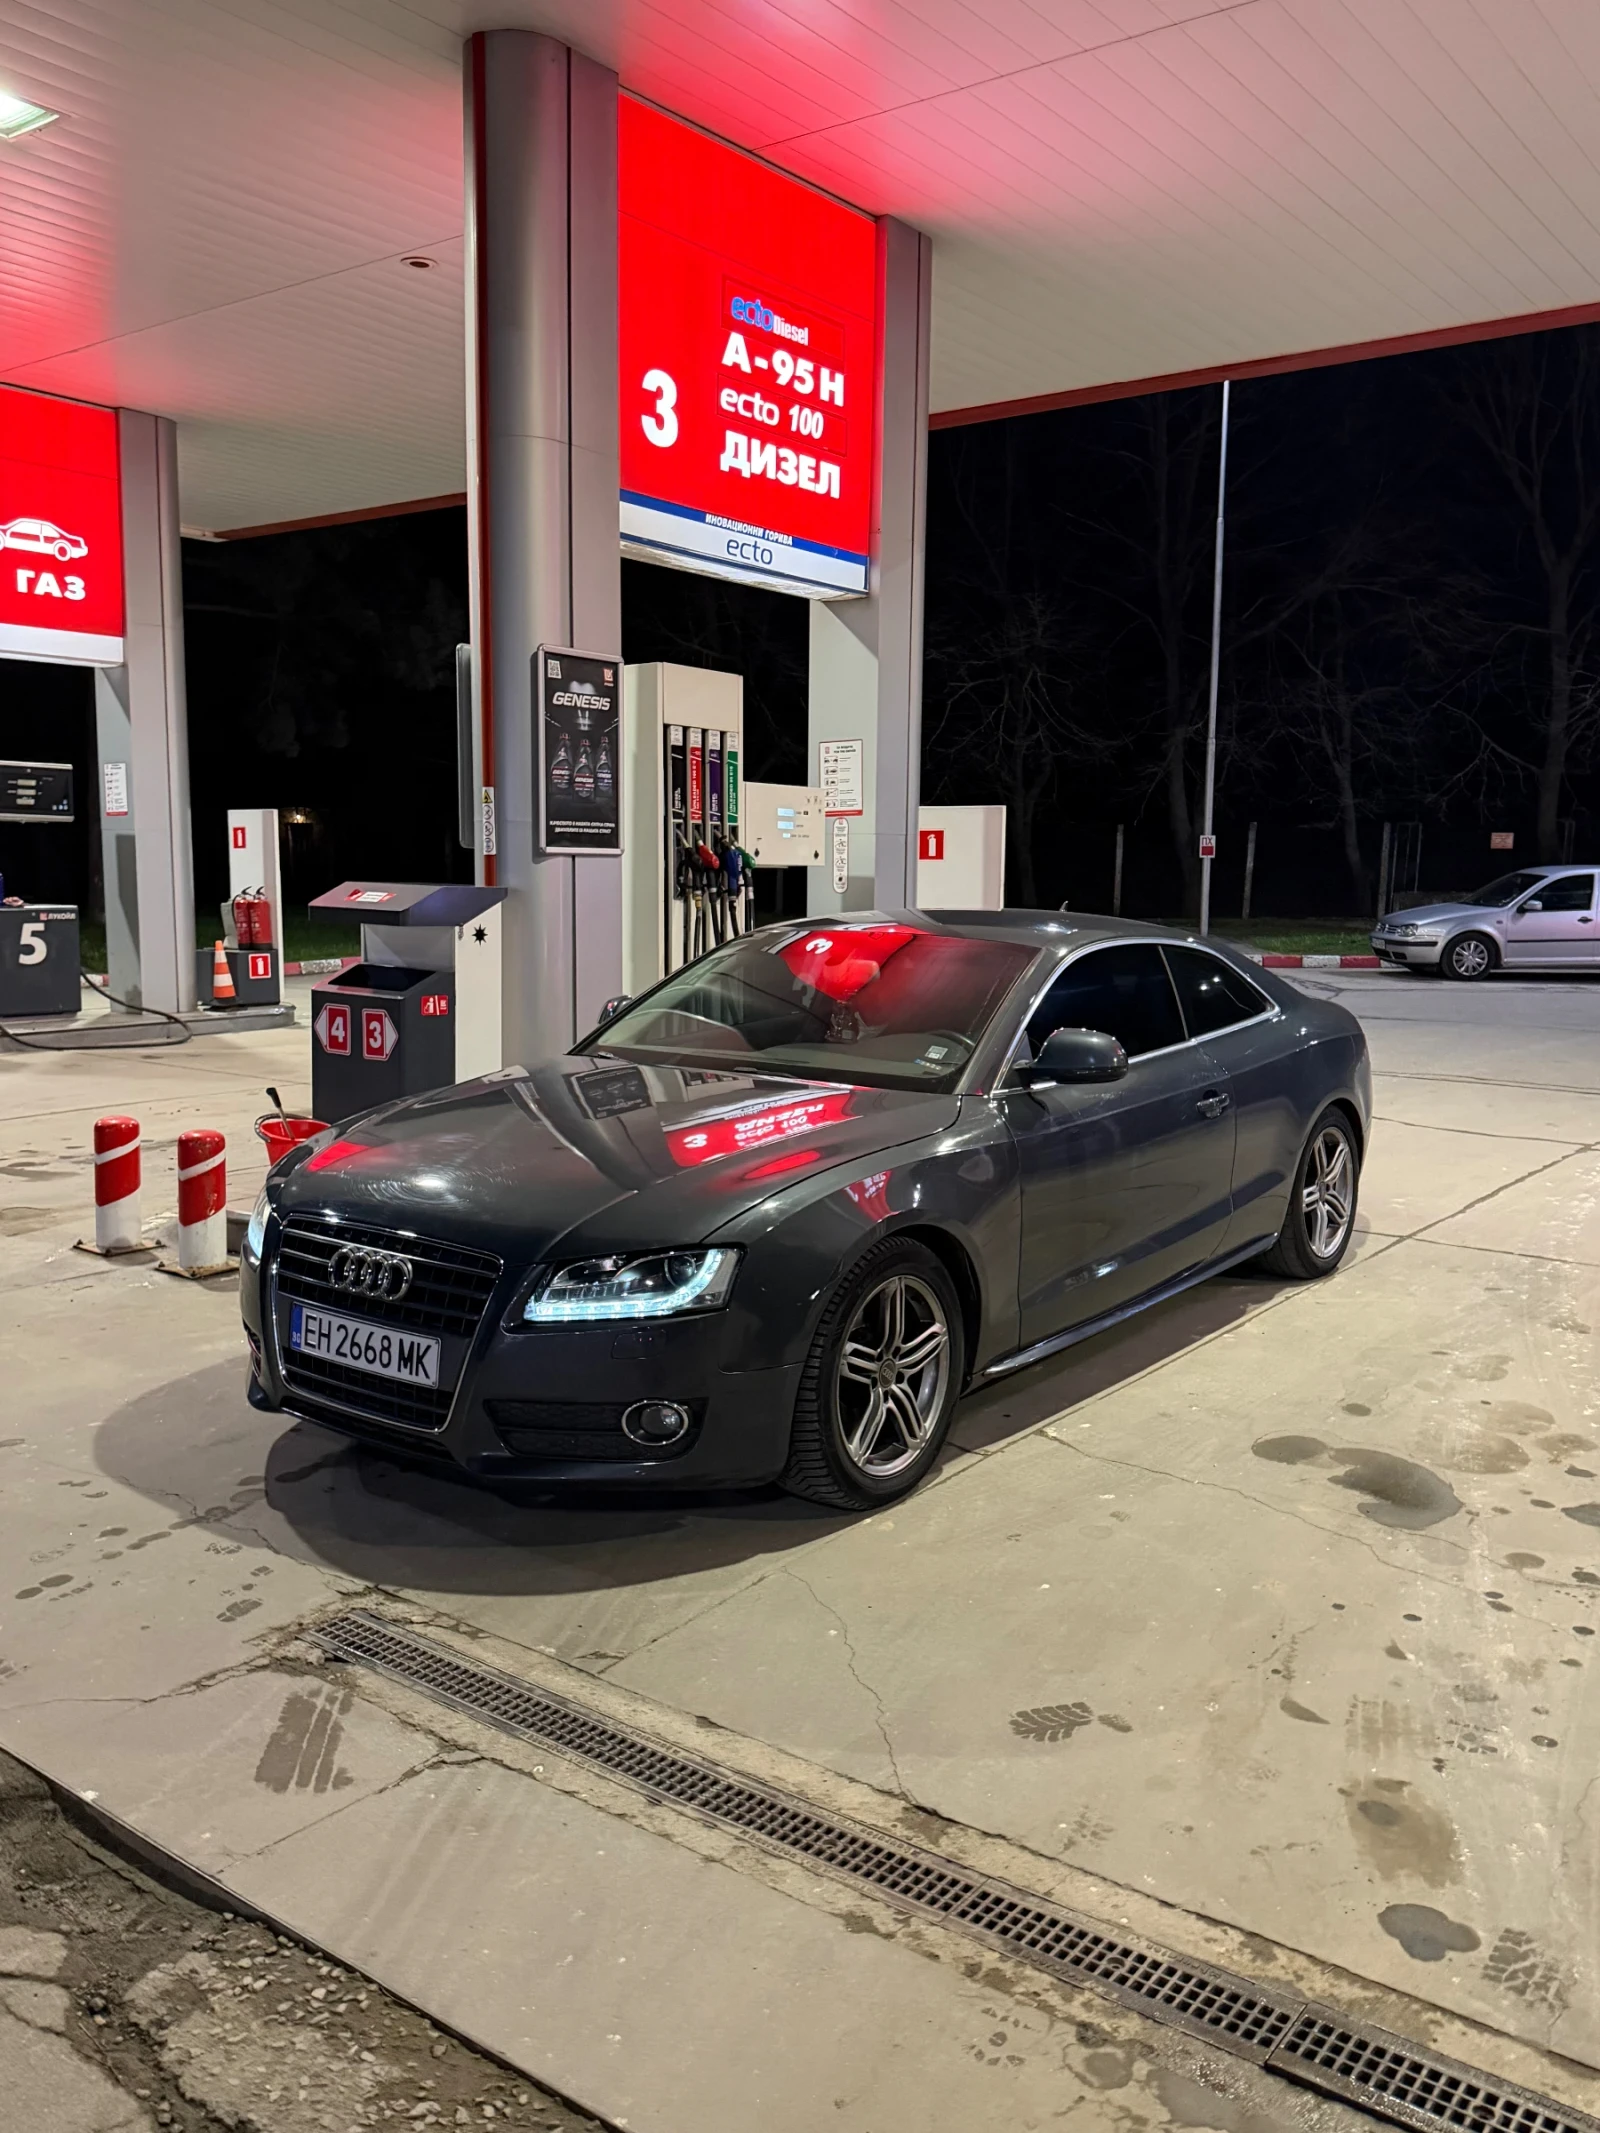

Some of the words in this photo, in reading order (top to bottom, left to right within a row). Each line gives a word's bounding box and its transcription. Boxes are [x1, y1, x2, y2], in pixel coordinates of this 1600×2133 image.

[641, 369, 679, 448] 3
[720, 388, 780, 426] ecto
[788, 404, 824, 439] 100
[720, 430, 841, 499] ДИЗЕЛ
[705, 513, 764, 537] ИНОВАЦИОННИ
[764, 529, 793, 546] ГОРИВА
[726, 539, 773, 565] ecto
[16, 568, 87, 601] ГАЗ
[552, 691, 611, 711] GENESIS
[19, 922, 47, 965] 5
[331, 1016, 345, 1043] 4
[369, 1020, 382, 1048] 3
